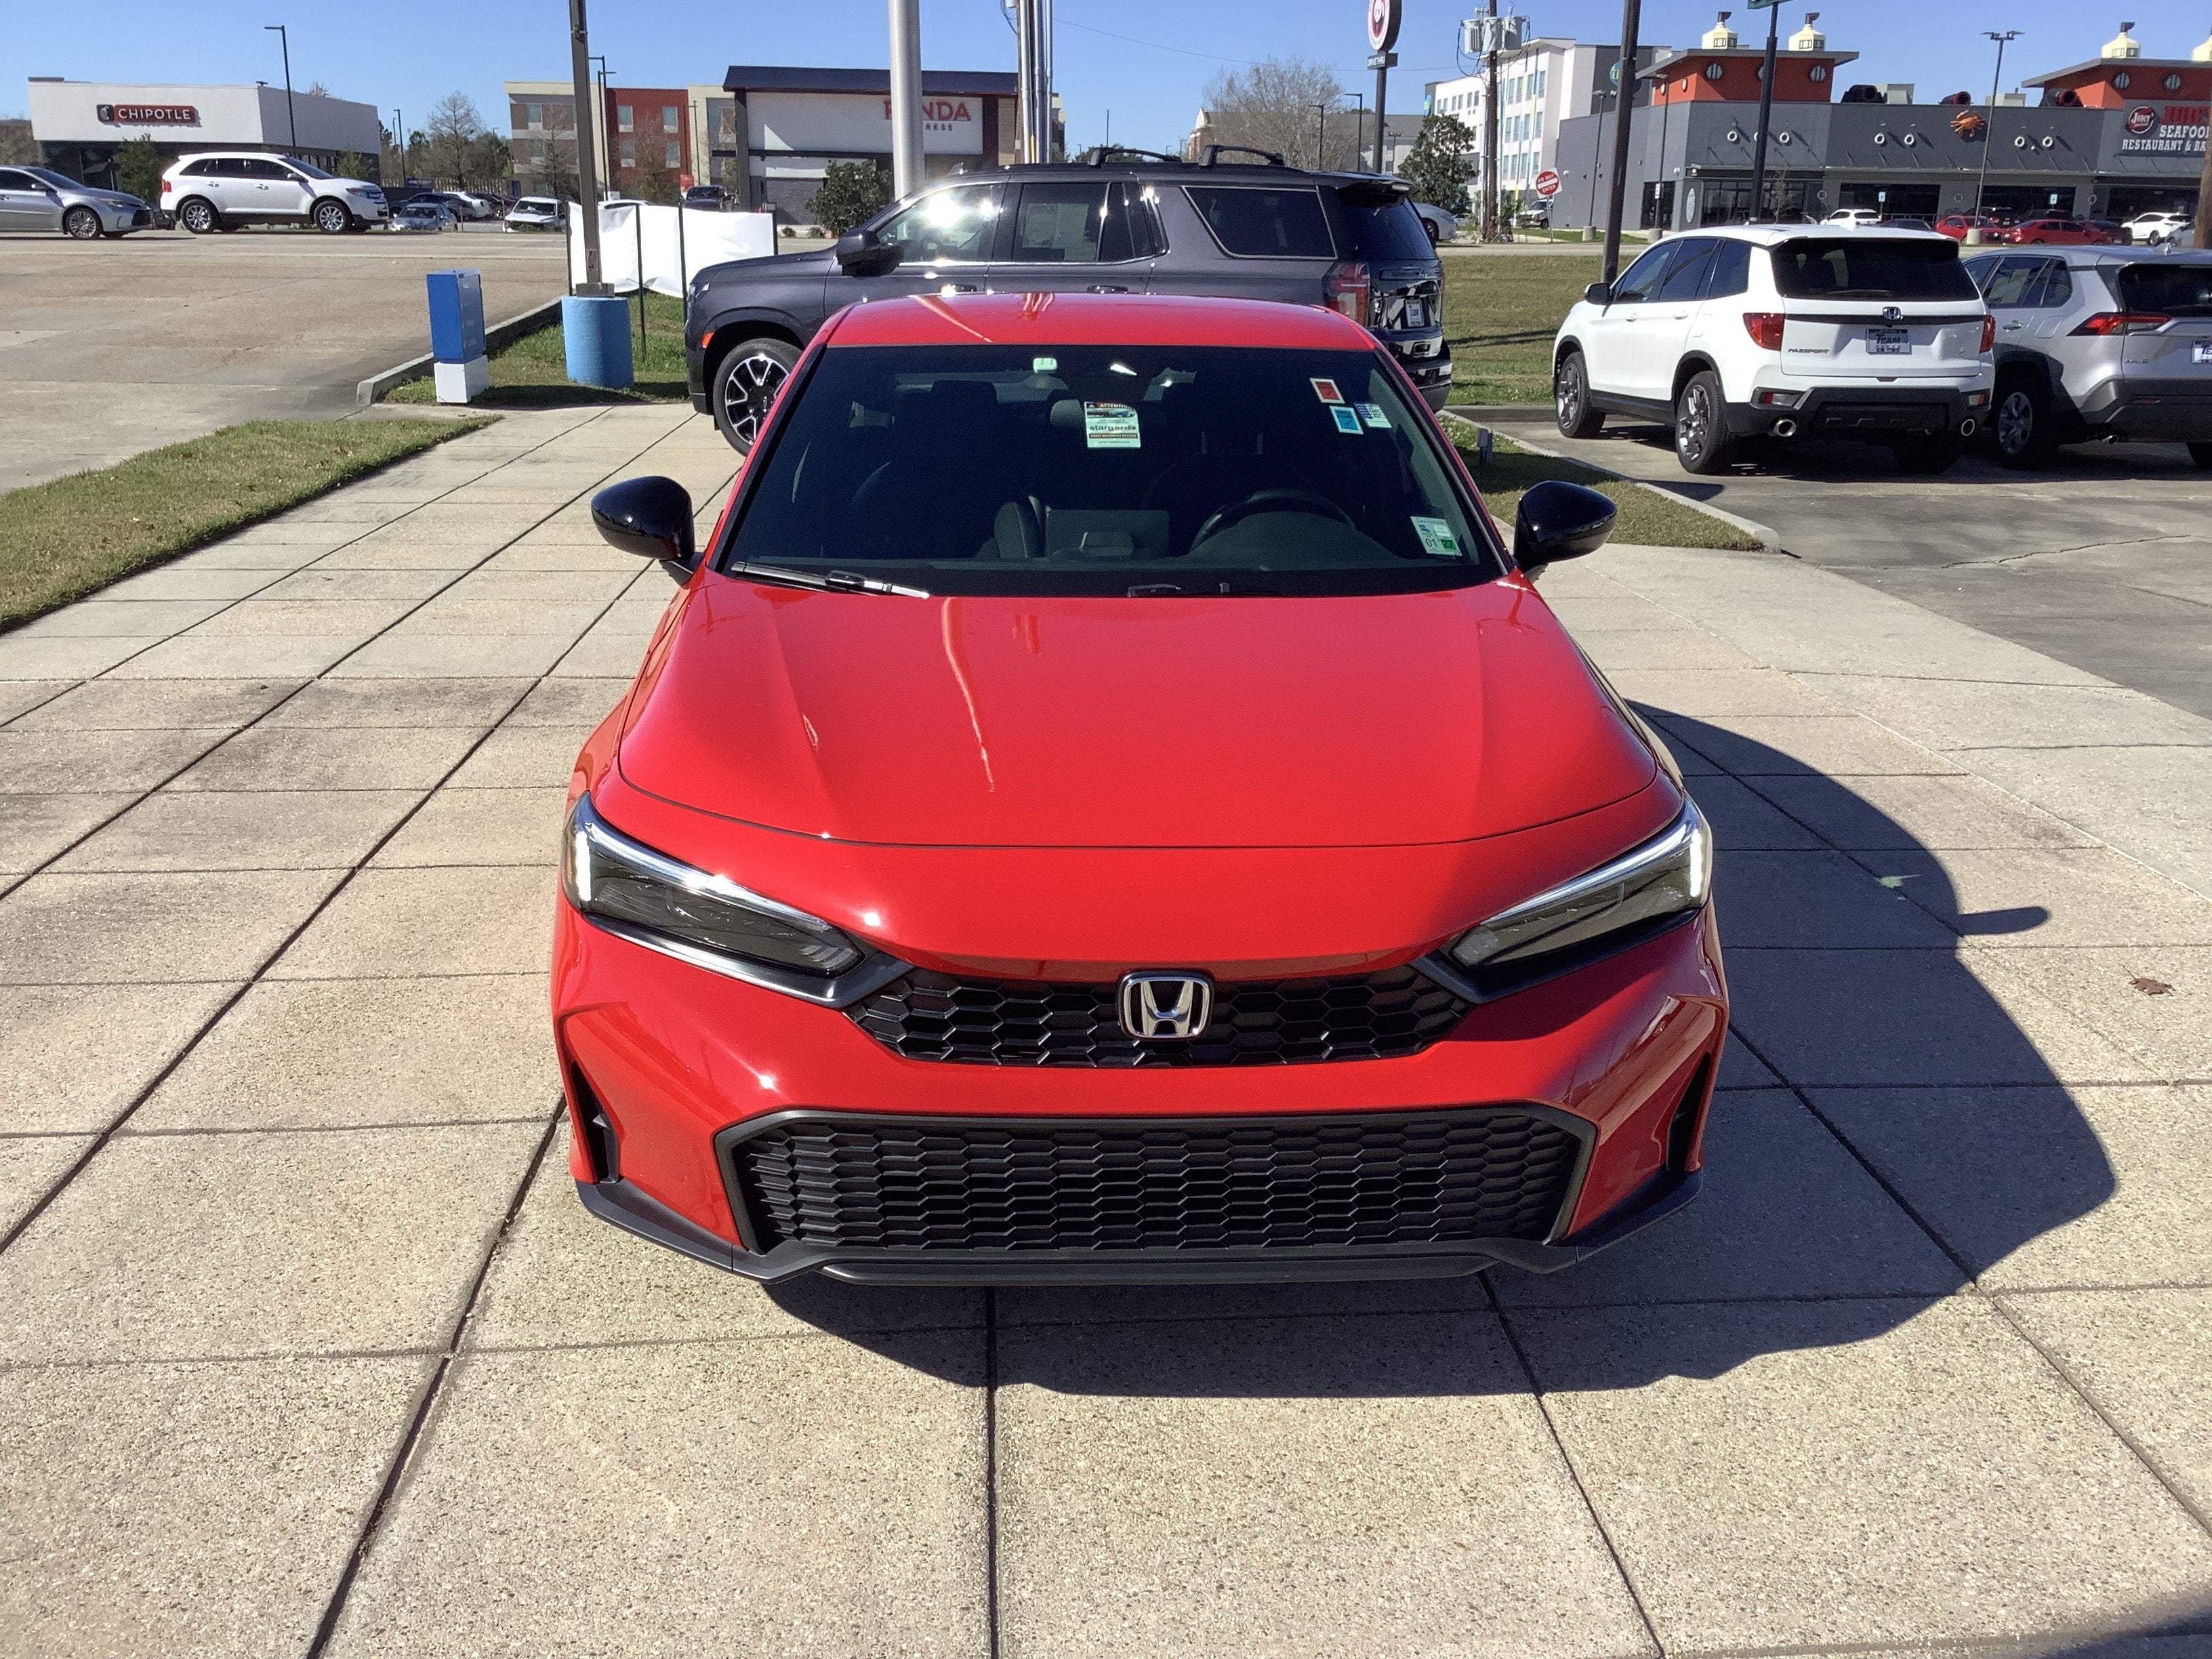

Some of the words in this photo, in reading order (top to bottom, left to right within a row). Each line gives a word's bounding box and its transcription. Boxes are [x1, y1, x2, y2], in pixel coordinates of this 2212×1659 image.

[118, 108, 191, 120] CHIPOTLE
[2122, 139, 2184, 150] RESTAURANT
[2185, 140, 2192, 151] &
[2194, 140, 2207, 151] BA
[1542, 184, 1556, 192] ENTER
[2202, 345, 2212, 354] TE
[1425, 538, 1437, 548] 01
